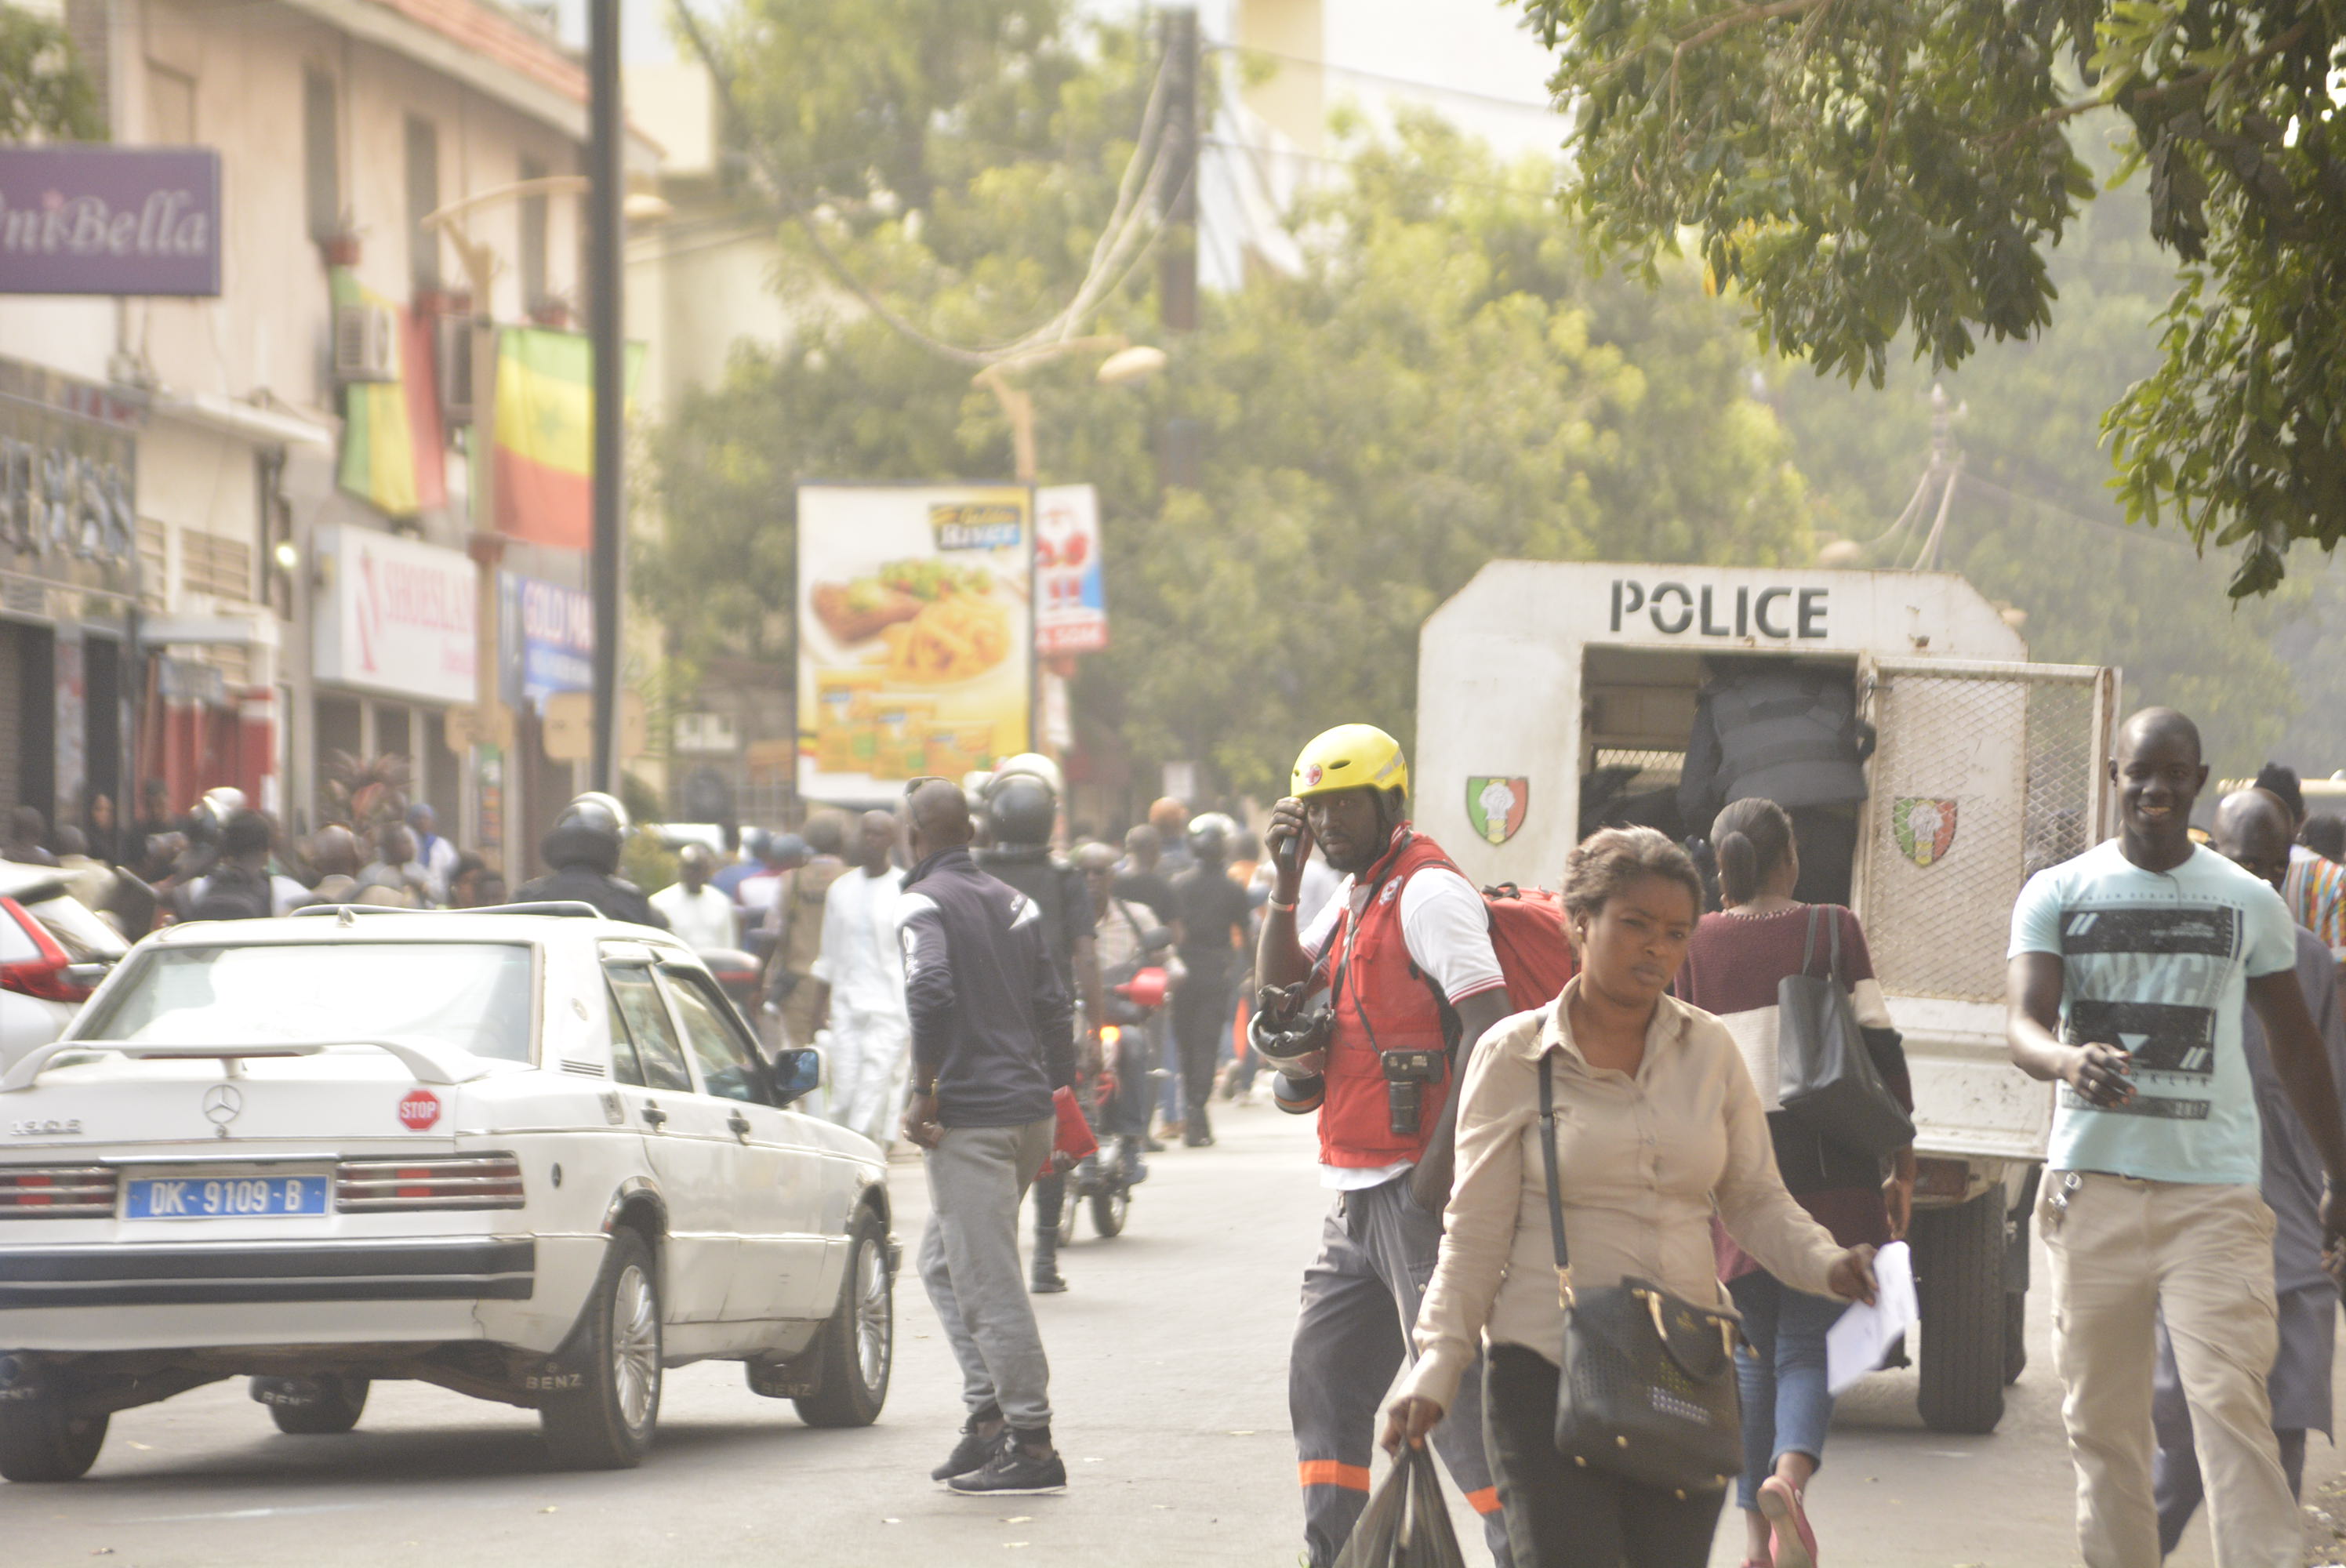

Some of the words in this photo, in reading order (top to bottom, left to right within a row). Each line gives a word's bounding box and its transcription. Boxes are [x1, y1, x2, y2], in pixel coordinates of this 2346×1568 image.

[0, 188, 207, 257] niBella
[1610, 579, 1829, 639] POLICE
[401, 1101, 438, 1119] STOP
[525, 1373, 583, 1390] BENZ
[761, 1381, 812, 1396] BENZ
